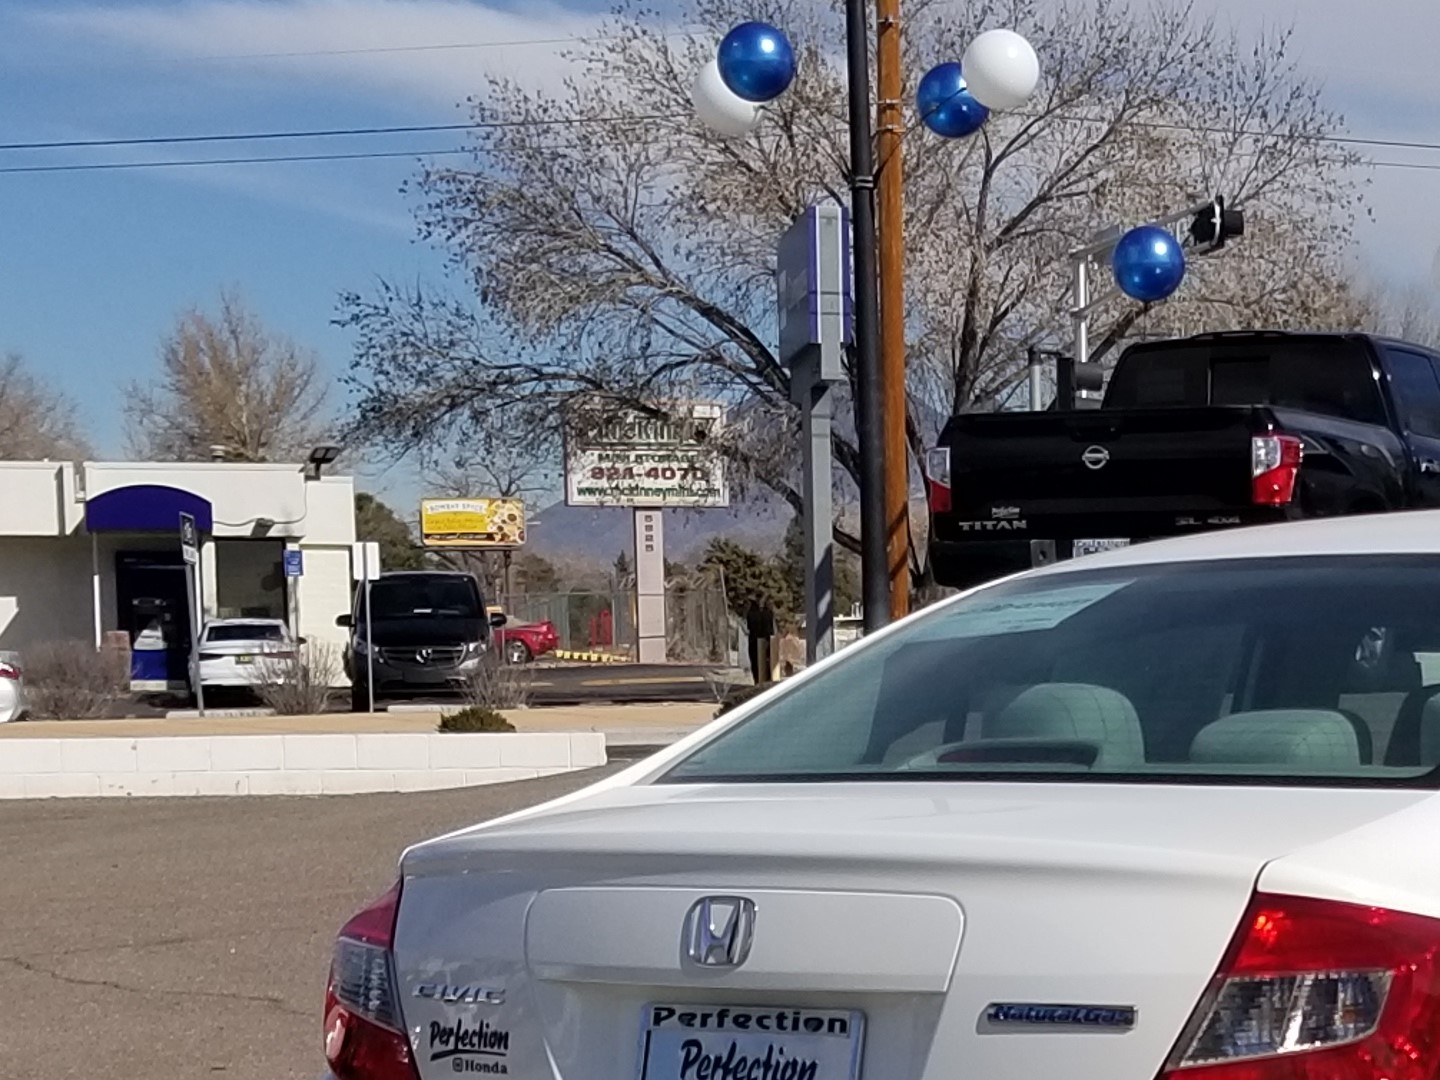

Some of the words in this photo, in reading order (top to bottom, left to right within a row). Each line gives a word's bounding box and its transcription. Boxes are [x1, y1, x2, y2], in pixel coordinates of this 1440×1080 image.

[959, 520, 1027, 531] TITAN
[412, 984, 506, 1004] CIVIC
[652, 1006, 848, 1034] Perfection
[429, 1018, 509, 1051] Perfection
[465, 1060, 508, 1075] Honda
